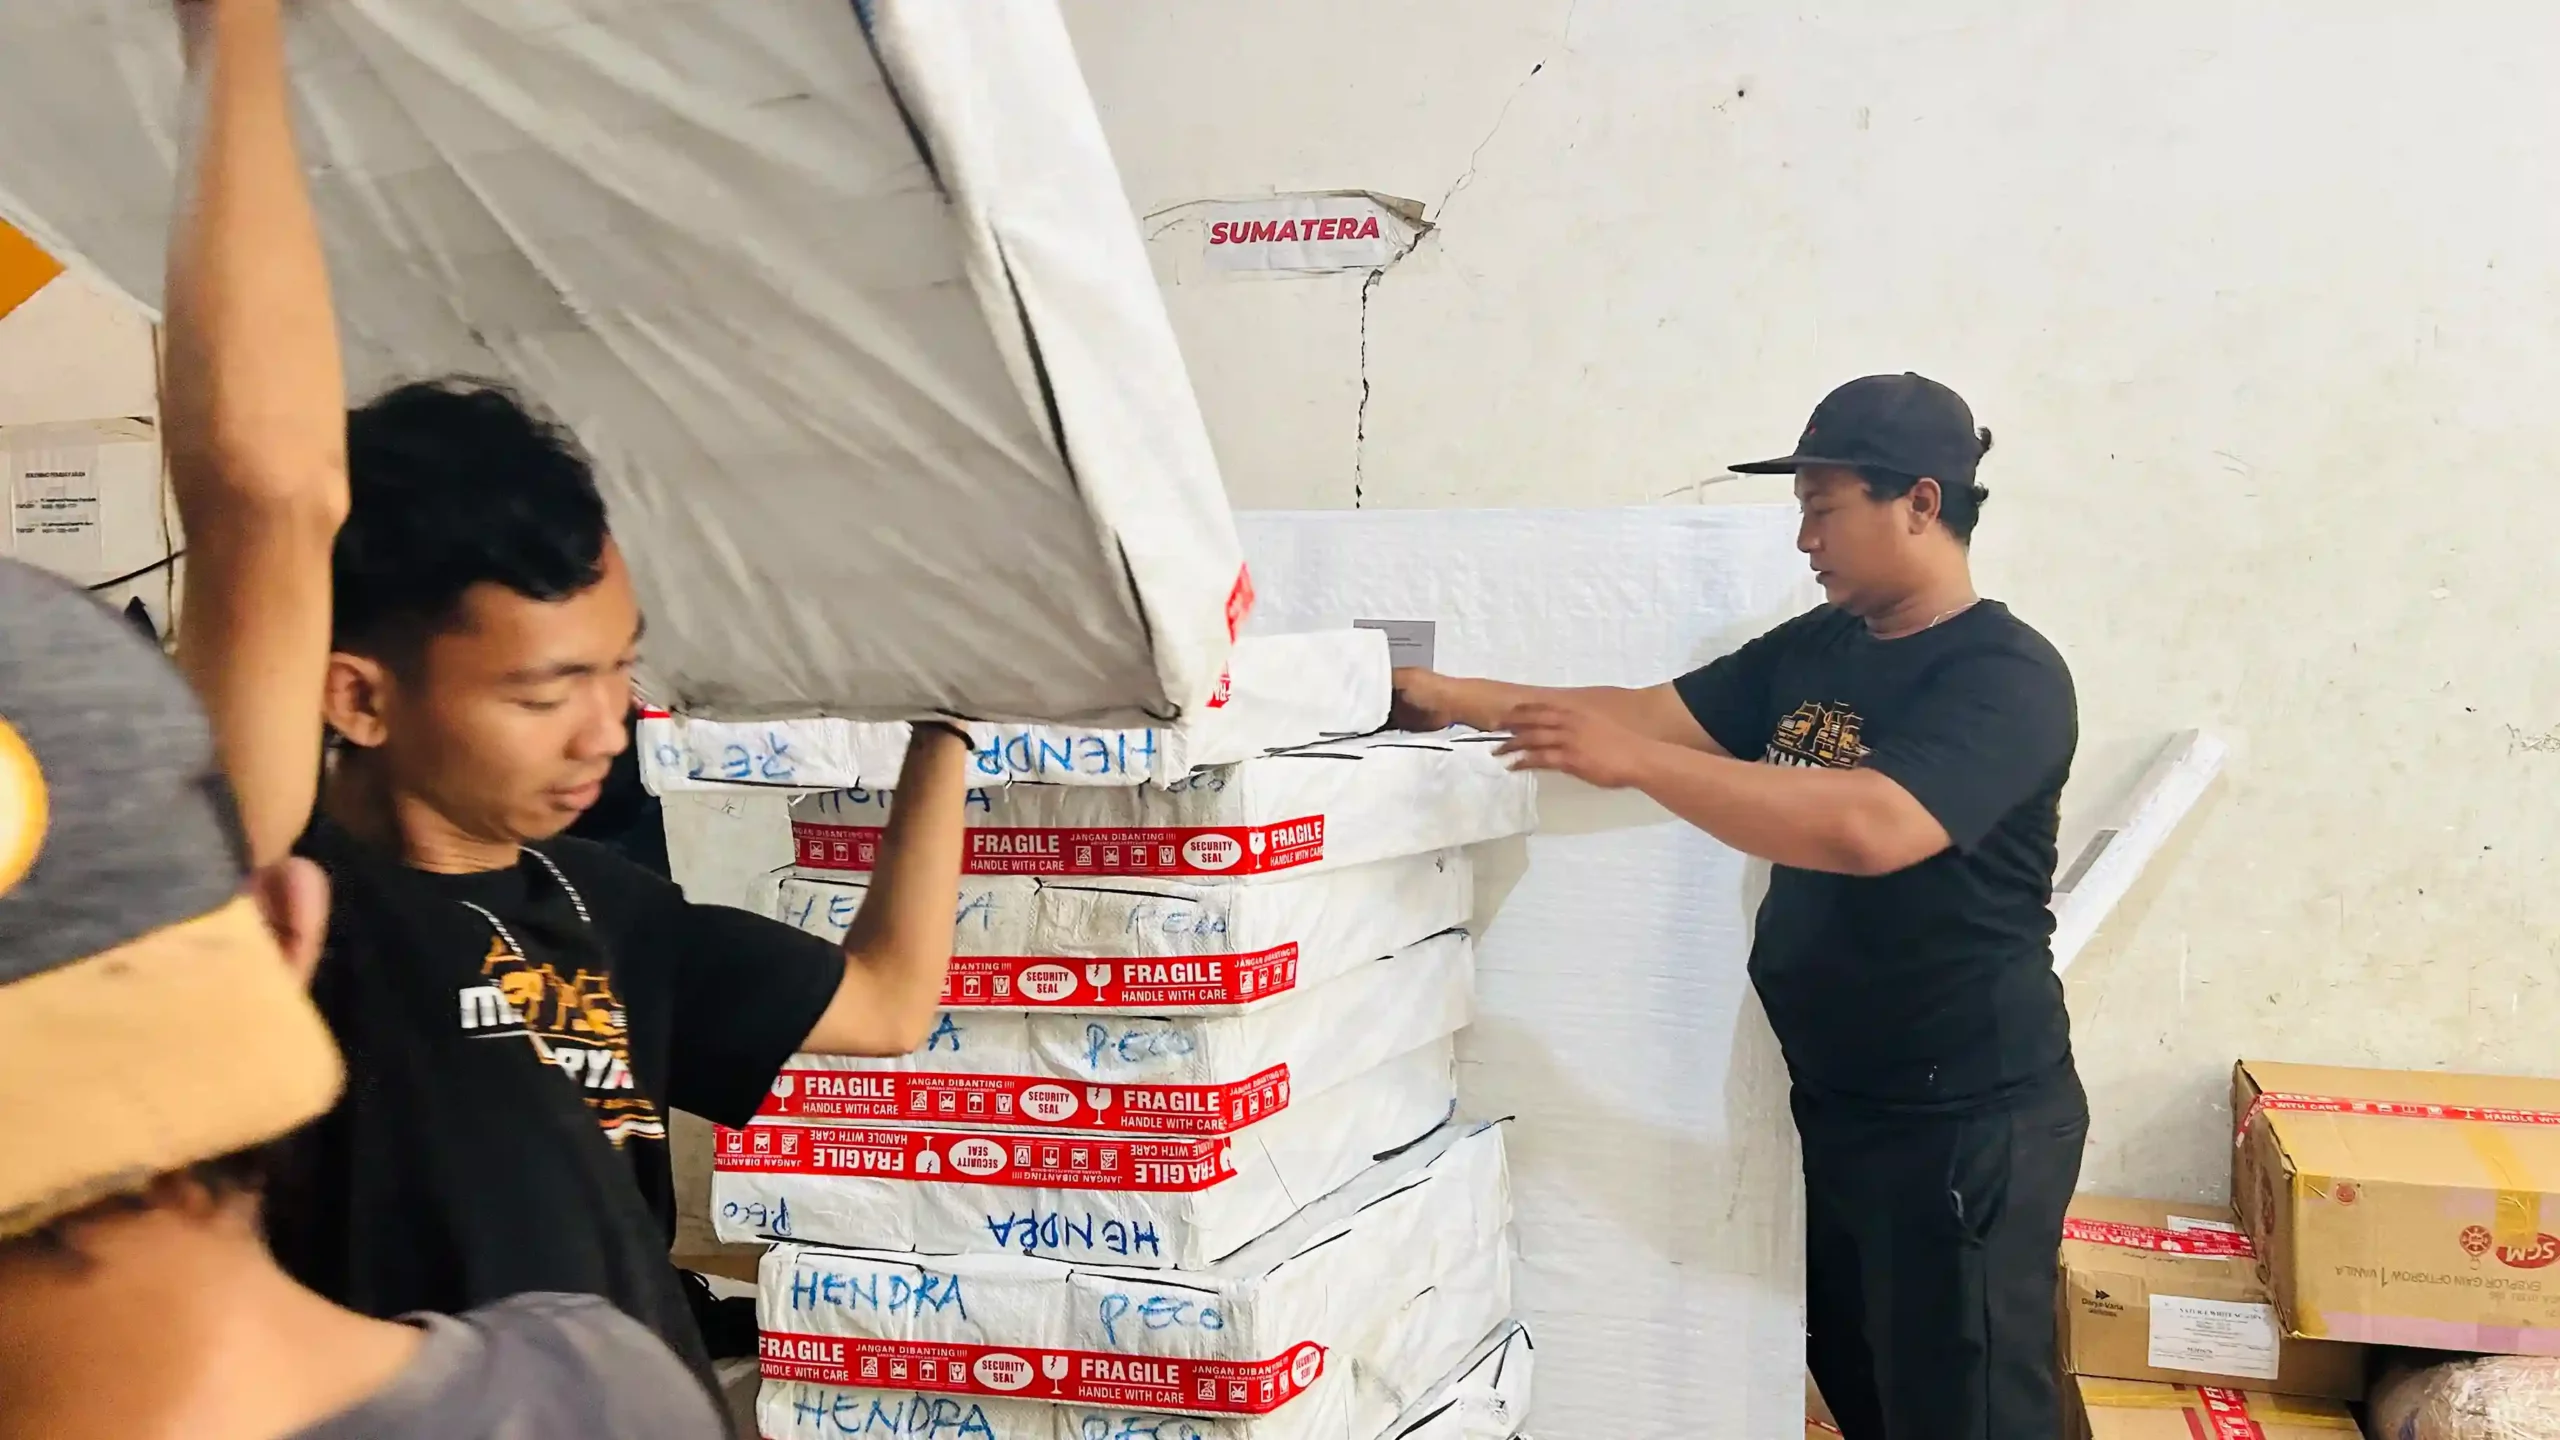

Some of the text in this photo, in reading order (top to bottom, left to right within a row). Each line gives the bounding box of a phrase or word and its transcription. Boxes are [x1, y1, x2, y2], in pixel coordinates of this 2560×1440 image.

[1209, 216, 1381, 245] SUMATERA
[976, 728, 1157, 775] HENDR
[1070, 833, 1108, 842] JANGAN
[1271, 821, 1322, 849] FRAGILE
[973, 834, 1060, 854] FRAGILE
[1190, 840, 1233, 852] SECURITY
[1201, 852, 1223, 863] SEAL
[970, 860, 1065, 871] HANDLE WITH CARE
[1026, 971, 1069, 982] SECURITY
[1123, 962, 1222, 984] FRAGILE
[1036, 983, 1059, 993] SEAL
[1121, 989, 1227, 1002] HANDLE WITH CARE
[805, 1076, 895, 1097] FRAGILE
[906, 1078, 945, 1087] JANGAN
[1028, 1091, 1070, 1103] SECURITY
[1123, 1090, 1220, 1112] FRAGILE
[802, 1102, 899, 1115] HANDLE WITH CARE
[1038, 1103, 1060, 1115] SEAL
[2275, 1102, 2341, 1111] WITH CARE
[1120, 1116, 1225, 1131] HANDLE WITH CARE
[2483, 1113, 2560, 1124] HANDLE WIT
[810, 1130, 908, 1145] HANDLE WITH CARE
[967, 1145, 989, 1156] SEAL
[1130, 1144, 1158, 1156] CARE
[1161, 1146, 1189, 1157] WITH
[763, 1158, 802, 1168] JANGAN
[813, 1148, 904, 1171] FRAGILE
[957, 1157, 999, 1169] SECURITY
[1134, 1157, 1216, 1184] FRAGILE
[1083, 1174, 1123, 1184] JANGAN
[983, 1208, 1160, 1257] HENDRA
[2063, 1228, 2155, 1249] FRAGIL
[2381, 1266, 2388, 1288] 1
[2454, 1275, 2483, 1288] GAIN
[790, 1269, 967, 1321] HENDRA
[759, 1336, 845, 1363] FRAGILE
[855, 1344, 895, 1354] JANGAN
[760, 1364, 849, 1381] ANDLE WITH CARE
[982, 1360, 1025, 1373] SECURITY
[1081, 1358, 1180, 1385] FRAGILE
[1192, 1365, 1235, 1376] JANGAN
[993, 1372, 1015, 1384] SEAL
[1078, 1386, 1185, 1404] HANDLE WITH CARE
[793, 1390, 995, 1440] HENDRA
